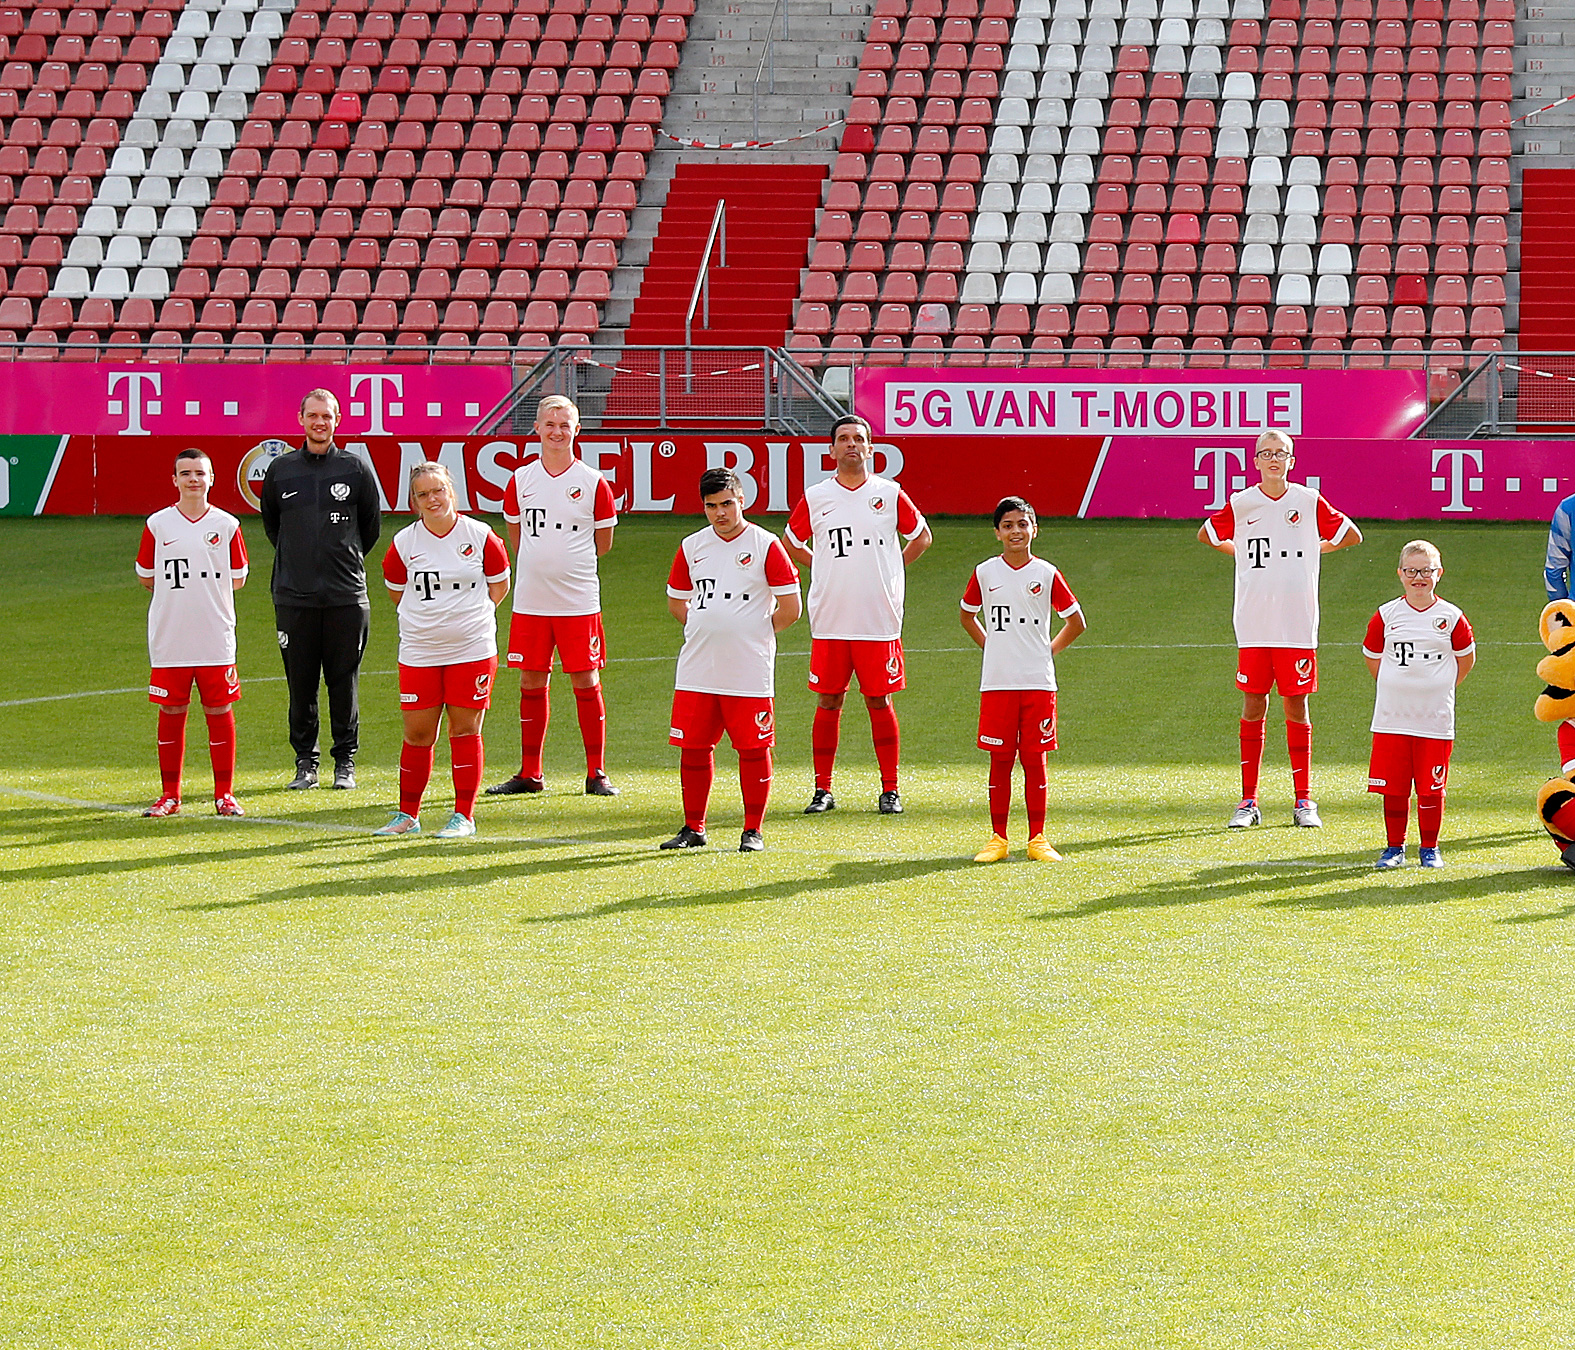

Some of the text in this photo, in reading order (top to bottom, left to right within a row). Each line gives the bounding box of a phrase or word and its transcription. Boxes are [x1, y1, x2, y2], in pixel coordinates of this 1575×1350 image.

[1529, 60, 1543, 70] 13
[703, 82, 716, 92] 12
[1529, 87, 1542, 97] 12
[1527, 143, 1541, 152] 10
[894, 390, 1291, 428] 5G VAN T-MOBILE
